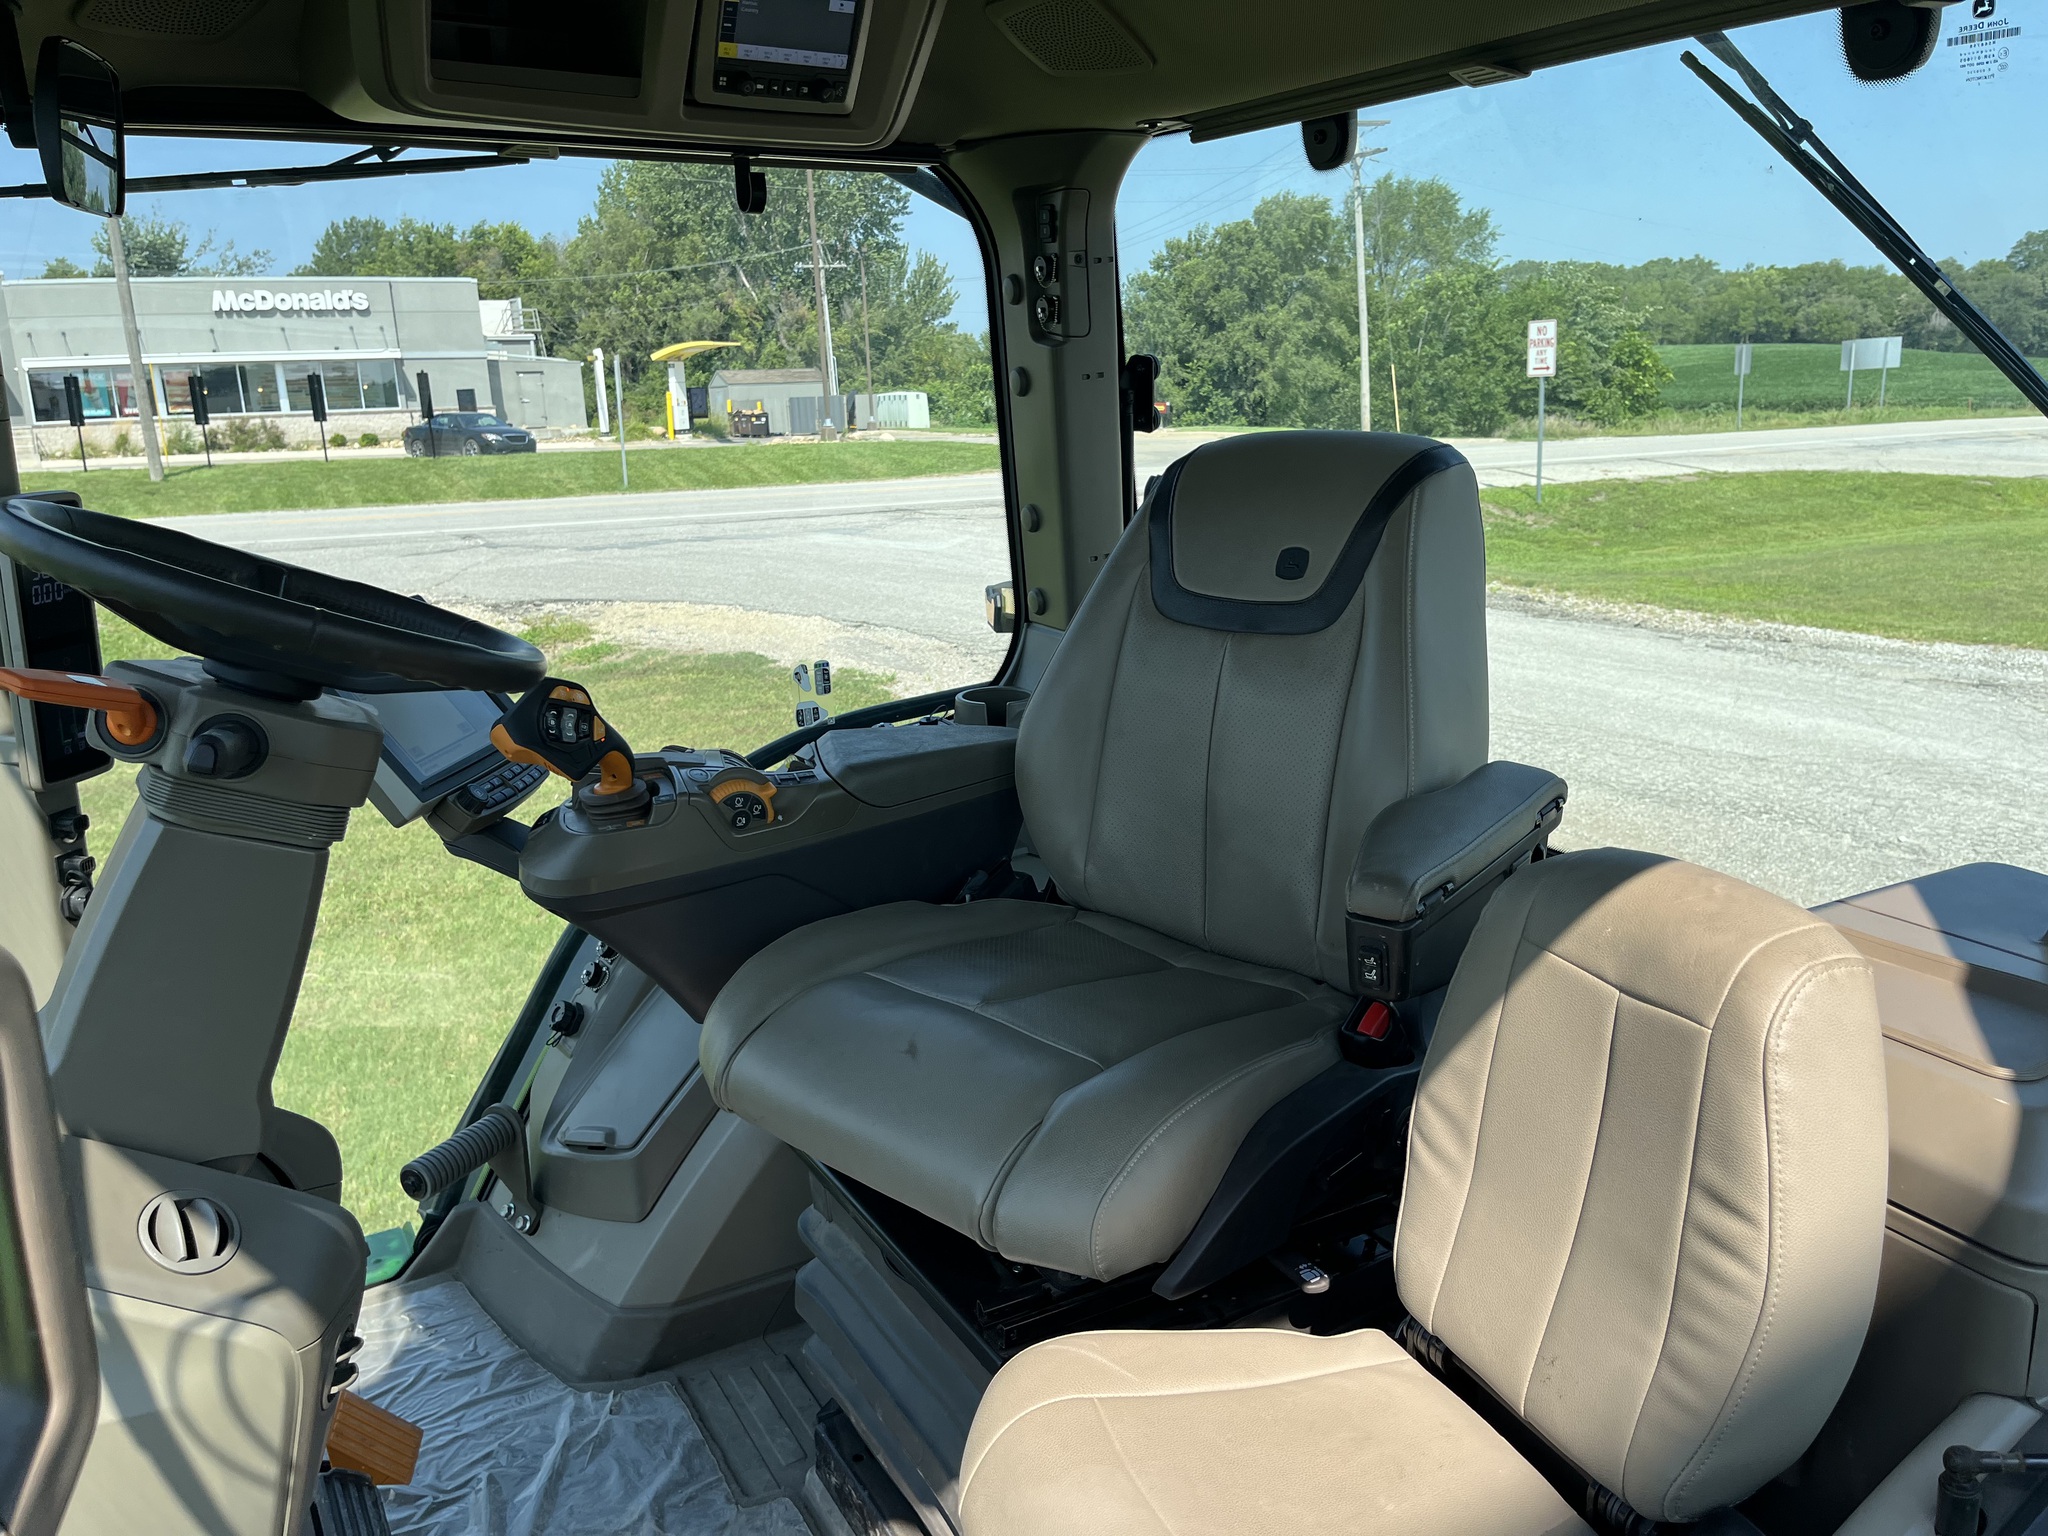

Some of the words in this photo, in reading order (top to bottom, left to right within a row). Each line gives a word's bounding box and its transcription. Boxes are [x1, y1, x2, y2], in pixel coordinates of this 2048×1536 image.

[212, 289, 369, 312] McDonald's
[1536, 326, 1548, 336] NO
[1529, 338, 1555, 348] PARKING
